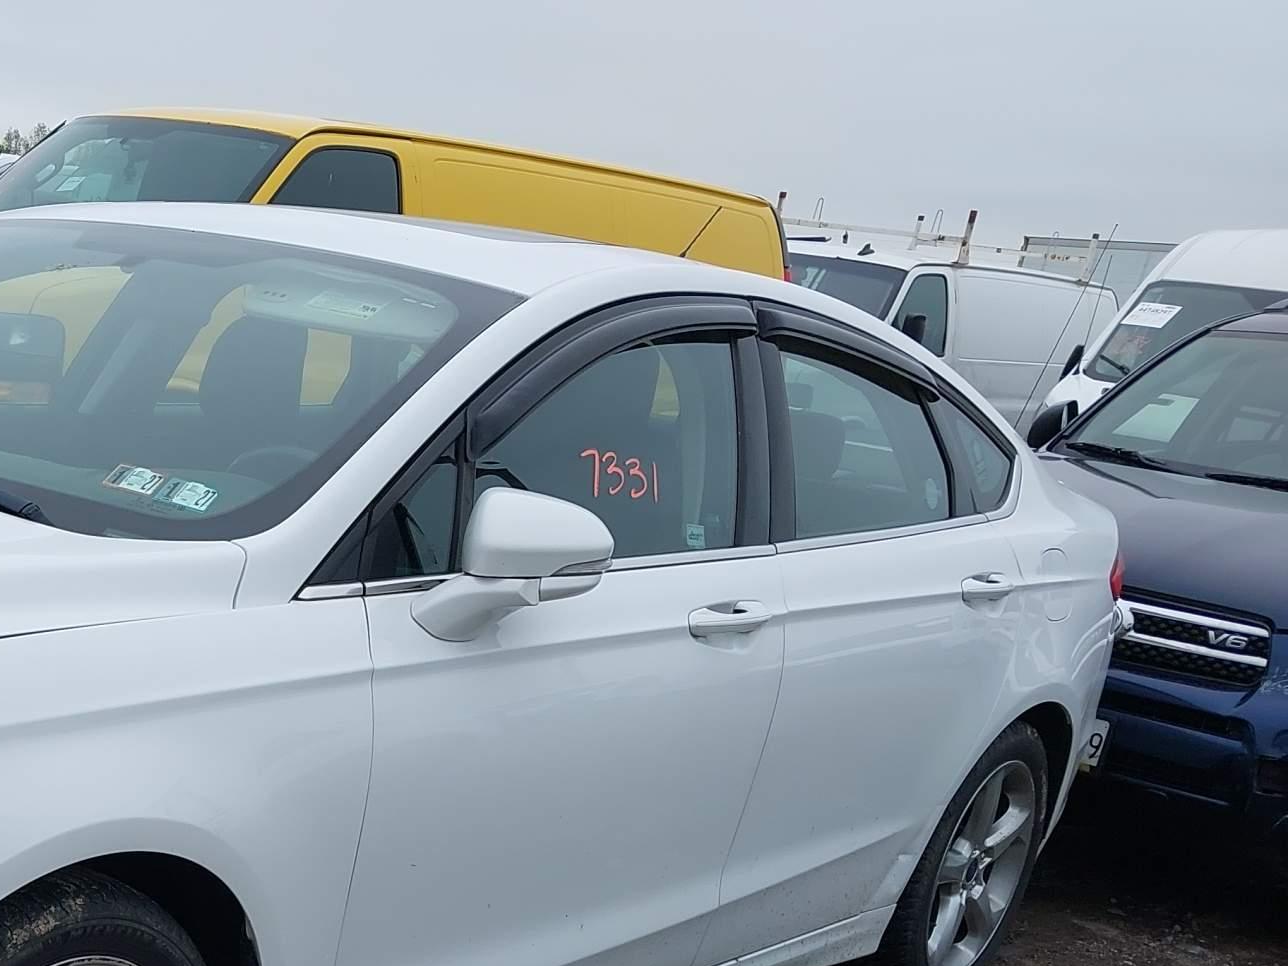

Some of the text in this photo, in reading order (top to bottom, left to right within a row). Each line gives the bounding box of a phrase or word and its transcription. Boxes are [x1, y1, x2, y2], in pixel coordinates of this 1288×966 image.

[139, 474, 163, 493] 27
[580, 447, 659, 504] 7331
[194, 489, 217, 508] 27
[1207, 630, 1249, 650] V6
